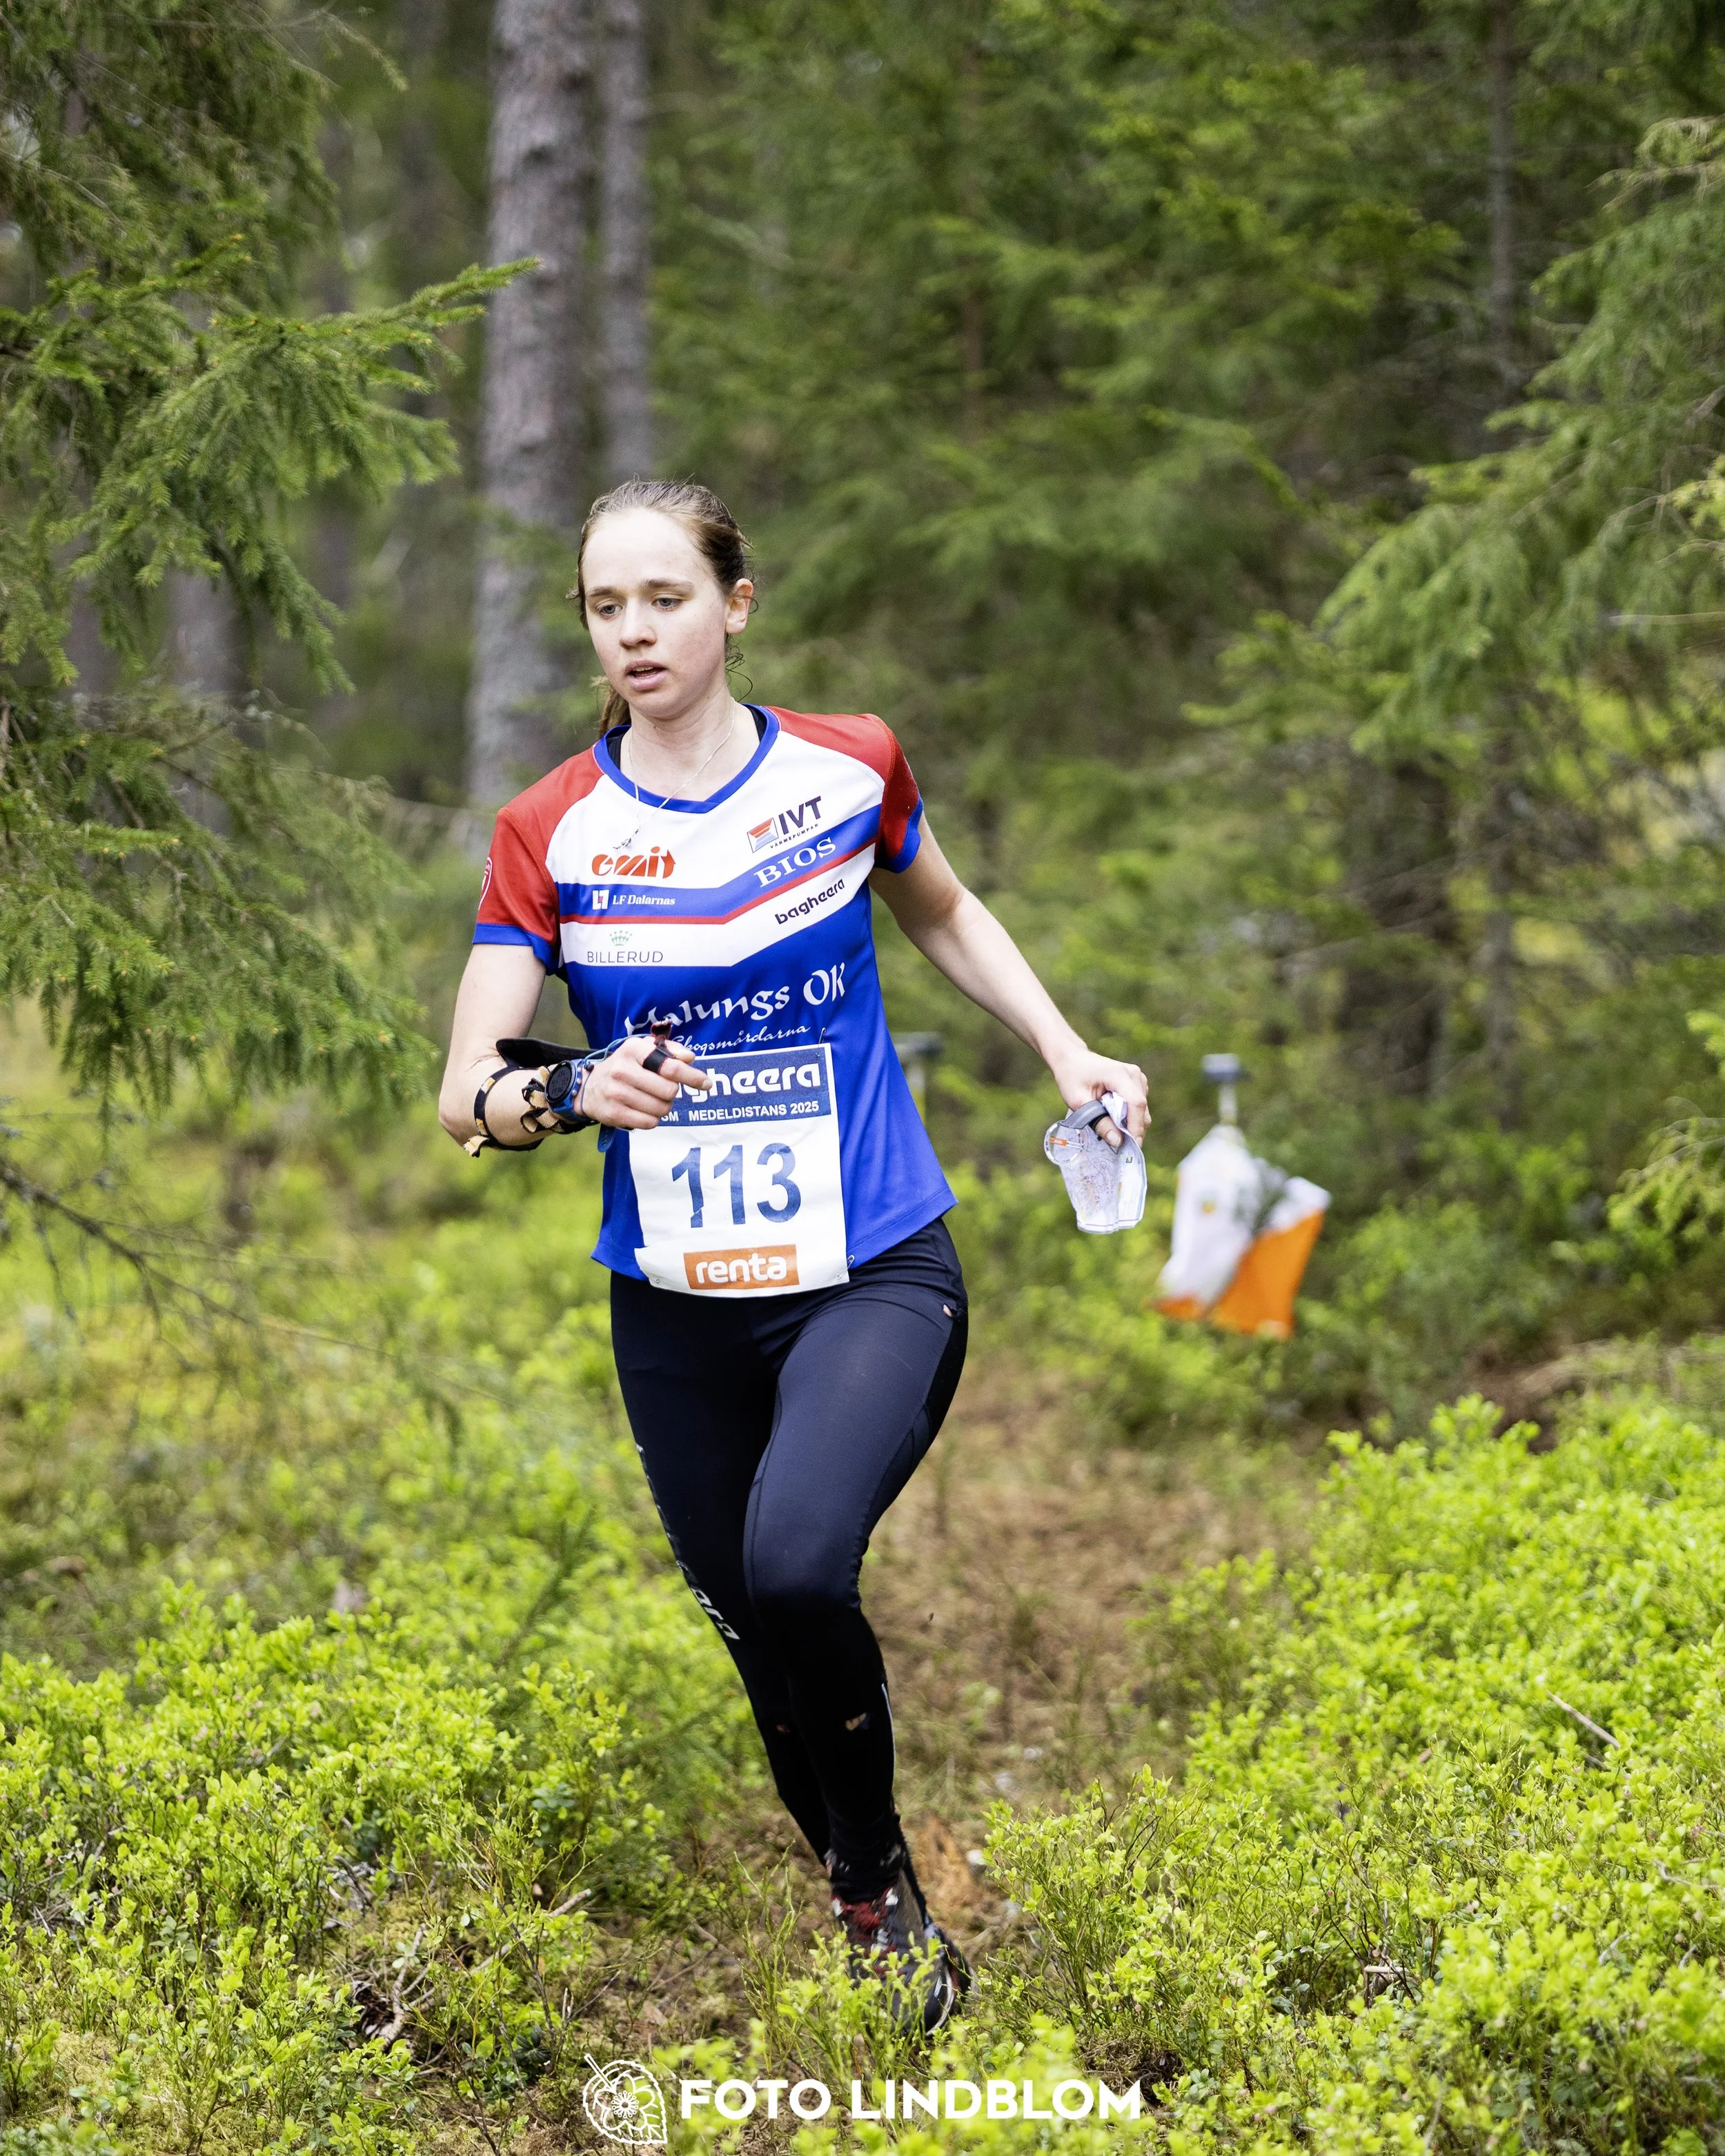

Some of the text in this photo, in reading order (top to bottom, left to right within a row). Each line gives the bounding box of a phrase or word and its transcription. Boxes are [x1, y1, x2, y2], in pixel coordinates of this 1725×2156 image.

[778, 795, 821, 835] IVT
[591, 846, 676, 879] emit
[753, 837, 836, 888] BIOS
[612, 894, 676, 905] LF Dalarnas
[774, 878, 845, 924] bagheera
[587, 951, 664, 963] BILLERUD
[803, 962, 846, 1006] OK
[676, 1062, 821, 1103] gheera
[688, 1104, 787, 1122] MEDELDISTANS
[790, 1100, 820, 1115] 2025
[671, 1142, 802, 1229] 113
[695, 1252, 787, 1284] renta
